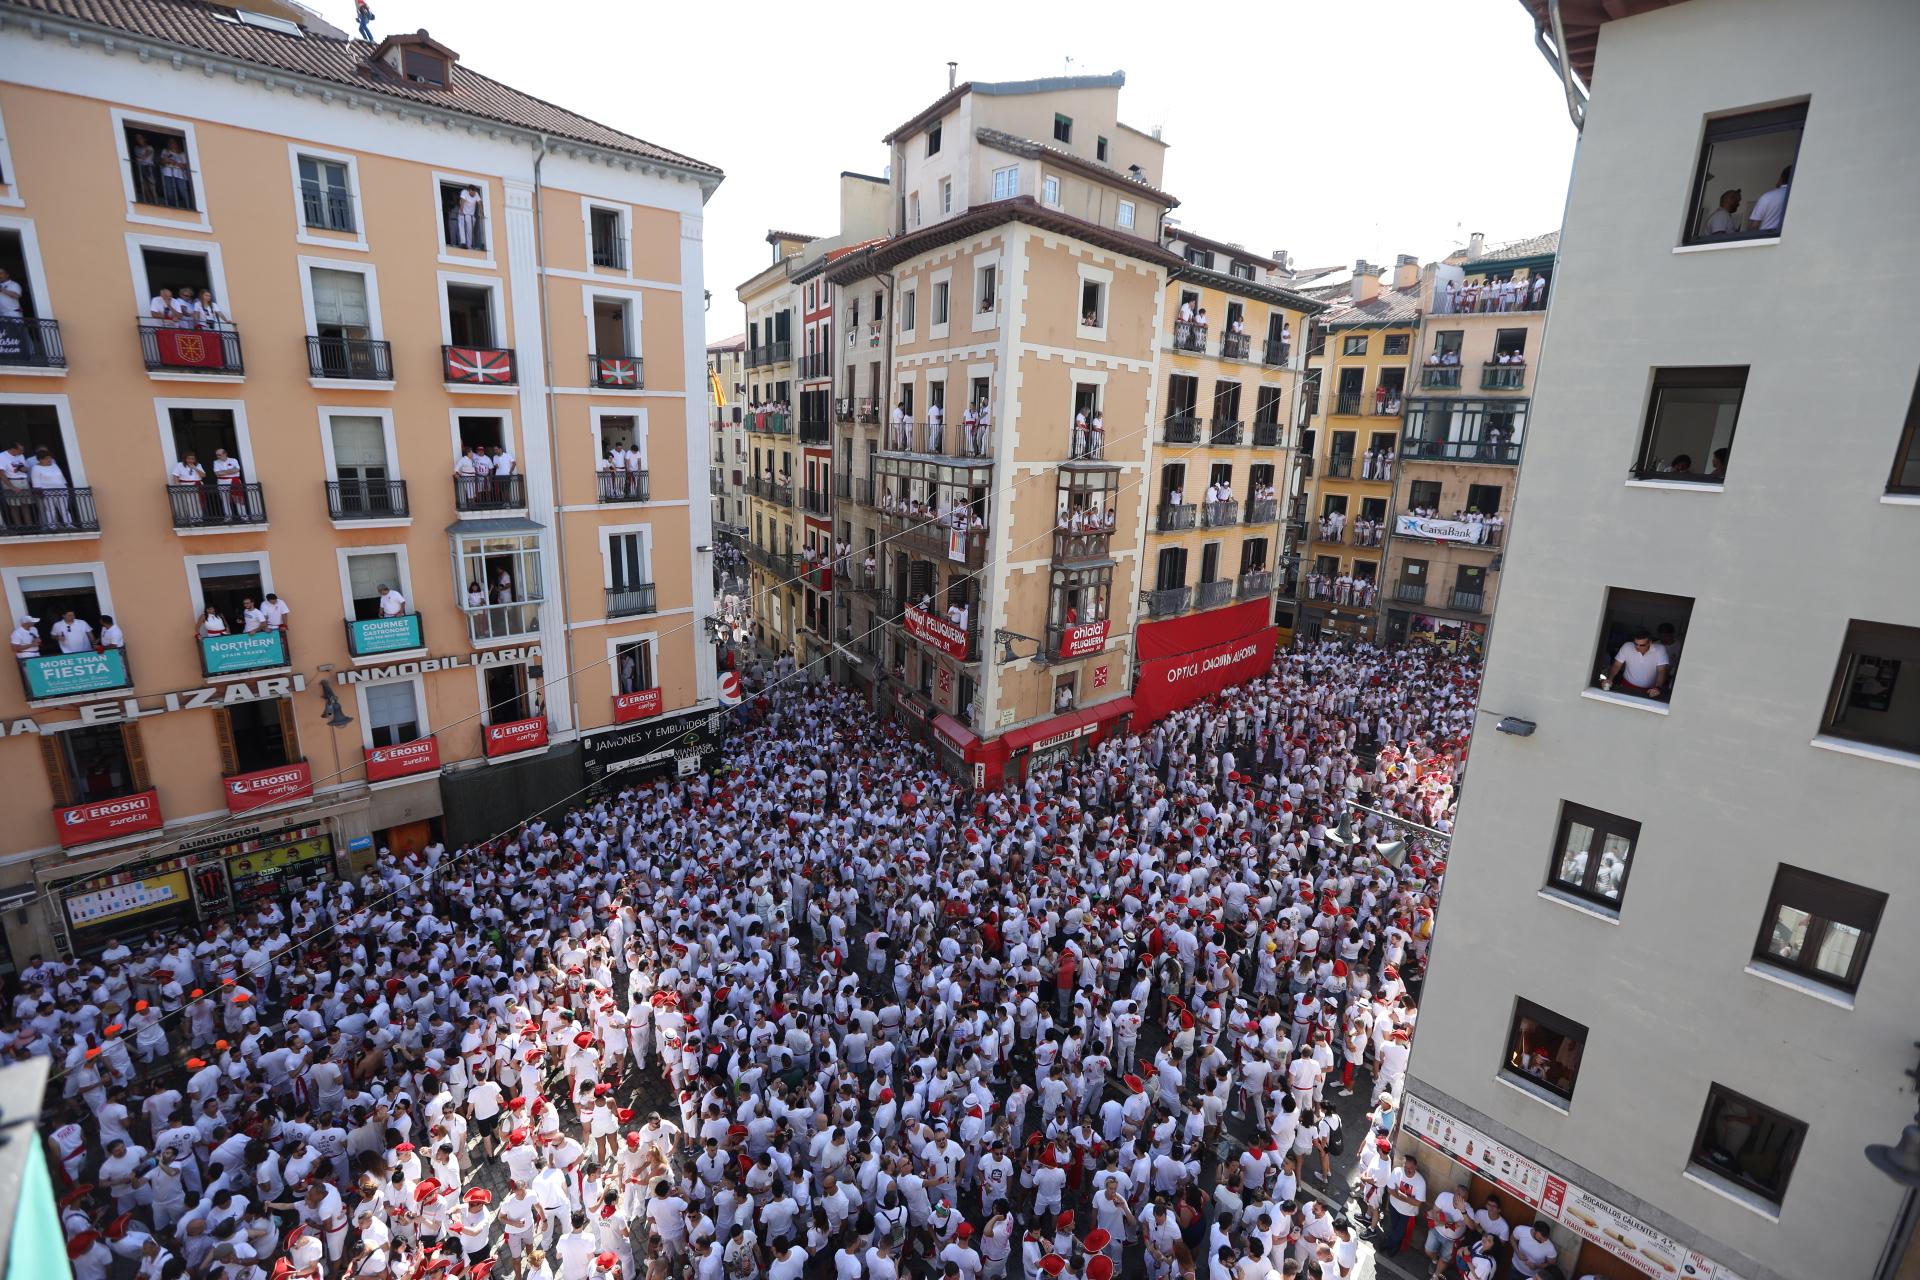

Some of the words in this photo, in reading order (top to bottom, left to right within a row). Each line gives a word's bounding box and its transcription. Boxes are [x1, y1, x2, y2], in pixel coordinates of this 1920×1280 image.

[1420, 523, 1472, 538] CaixaBank
[362, 619, 408, 631] GOURMET
[363, 626, 409, 637] GASTRONOMY
[211, 637, 274, 652] NORTHERN
[40, 658, 74, 669] MORE
[76, 654, 107, 664] THAN
[336, 645, 543, 686] INMOBILIARIA
[43, 663, 110, 680] FIESTA
[1167, 663, 1198, 683] OPTICA
[79, 673, 307, 725] ELIZARI
[629, 692, 657, 704] EROSKI
[638, 701, 657, 711] contigo
[505, 722, 539, 735] EROSKI
[595, 731, 642, 752] JAMONES
[645, 729, 653, 740] Y
[655, 717, 706, 737] EMBUTIDOS
[516, 731, 539, 742] contigo
[1039, 729, 1075, 748] GUTIERREZ
[389, 744, 430, 758] EROSKI
[402, 757, 430, 767] zurekin
[252, 772, 298, 788] EROSKI
[268, 784, 298, 795] contigo
[90, 800, 145, 818] EROSKI
[109, 814, 148, 827] zurekin
[1410, 1098, 1436, 1117] BEBIDAS
[1496, 1145, 1515, 1160] COLD
[1515, 1158, 1542, 1175] DRINKS
[1582, 1192, 1622, 1220] BOCADILLOS
[1622, 1214, 1658, 1240] CALIENTES
[1562, 1217, 1601, 1244] TRADITIONAL
[1602, 1240, 1618, 1252] HOT
[1617, 1248, 1662, 1279] SANDWICHES
